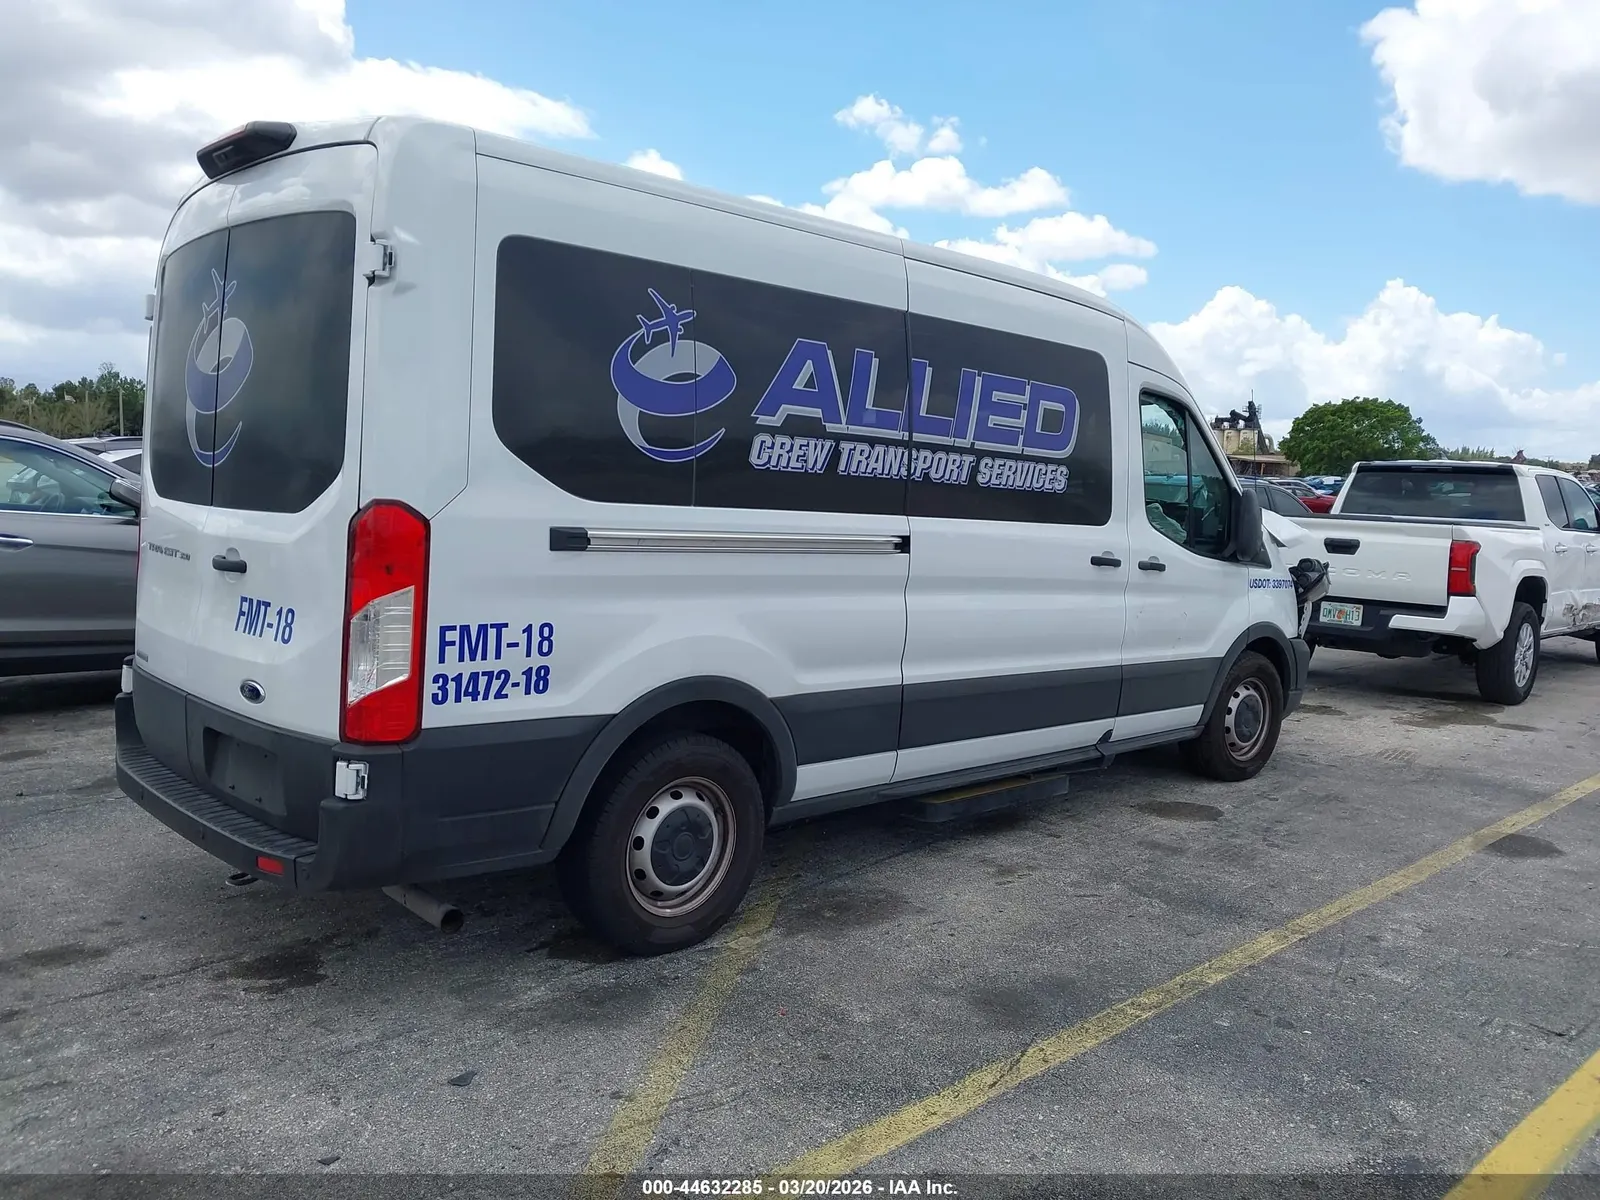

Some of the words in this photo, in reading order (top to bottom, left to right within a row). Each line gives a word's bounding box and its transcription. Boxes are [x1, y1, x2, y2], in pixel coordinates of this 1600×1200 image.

[751, 338, 1081, 459] ALLIED
[749, 433, 834, 474] CREW
[837, 442, 977, 485] TRANSPORT
[977, 457, 1070, 493] SERVICES
[1249, 578, 1271, 589] USDOT:
[234, 595, 296, 645] FMT-18
[438, 622, 554, 664] FMT-18
[431, 665, 550, 705] 31472-18
